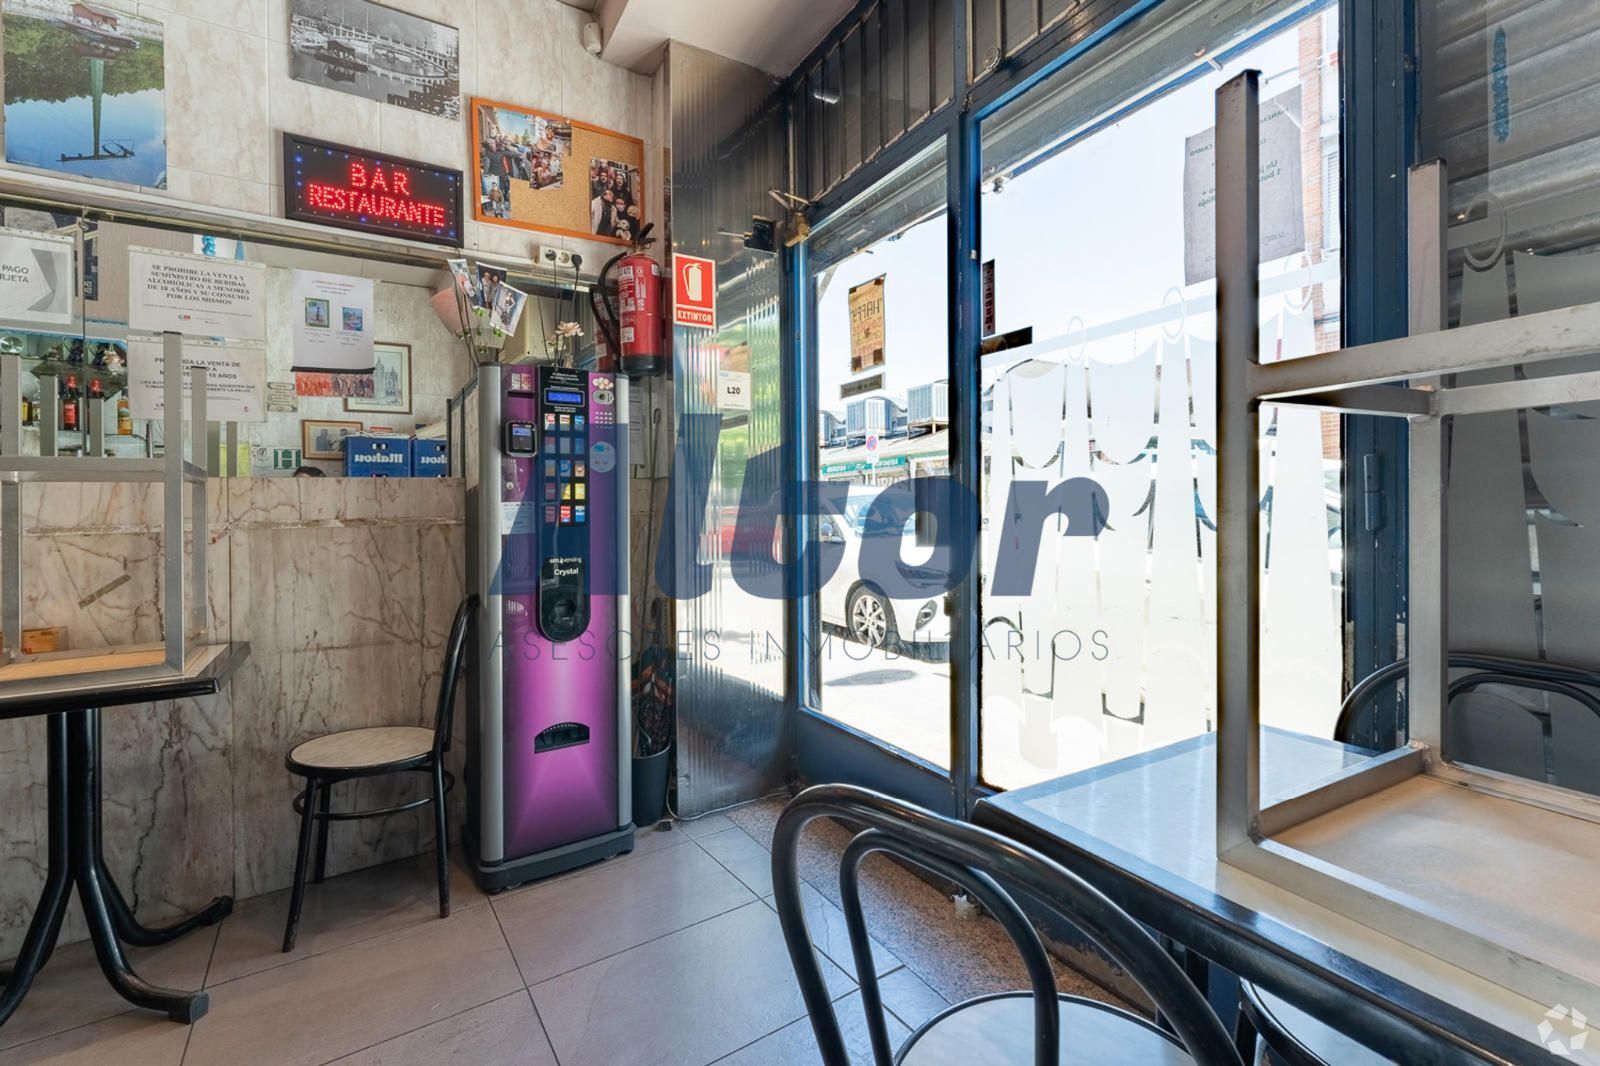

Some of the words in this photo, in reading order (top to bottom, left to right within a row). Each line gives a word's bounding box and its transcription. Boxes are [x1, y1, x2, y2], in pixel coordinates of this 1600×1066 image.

[352, 163, 410, 196] BAR
[309, 183, 445, 227] RESTAURANTE
[2, 264, 29, 274] PAGO
[163, 265, 199, 275] PROHIBE
[212, 270, 238, 281] VENTA
[150, 270, 201, 282] SUMINISTRO
[214, 278, 246, 288] BEBIDAS
[211, 291, 250, 301] CONSUMO
[213, 285, 250, 295] MENORES
[166, 292, 183, 300] POR
[201, 296, 232, 305] MISMOS
[677, 309, 713, 323] EXTINTOR
[727, 386, 741, 395] L20
[554, 567, 579, 576] Crystal
